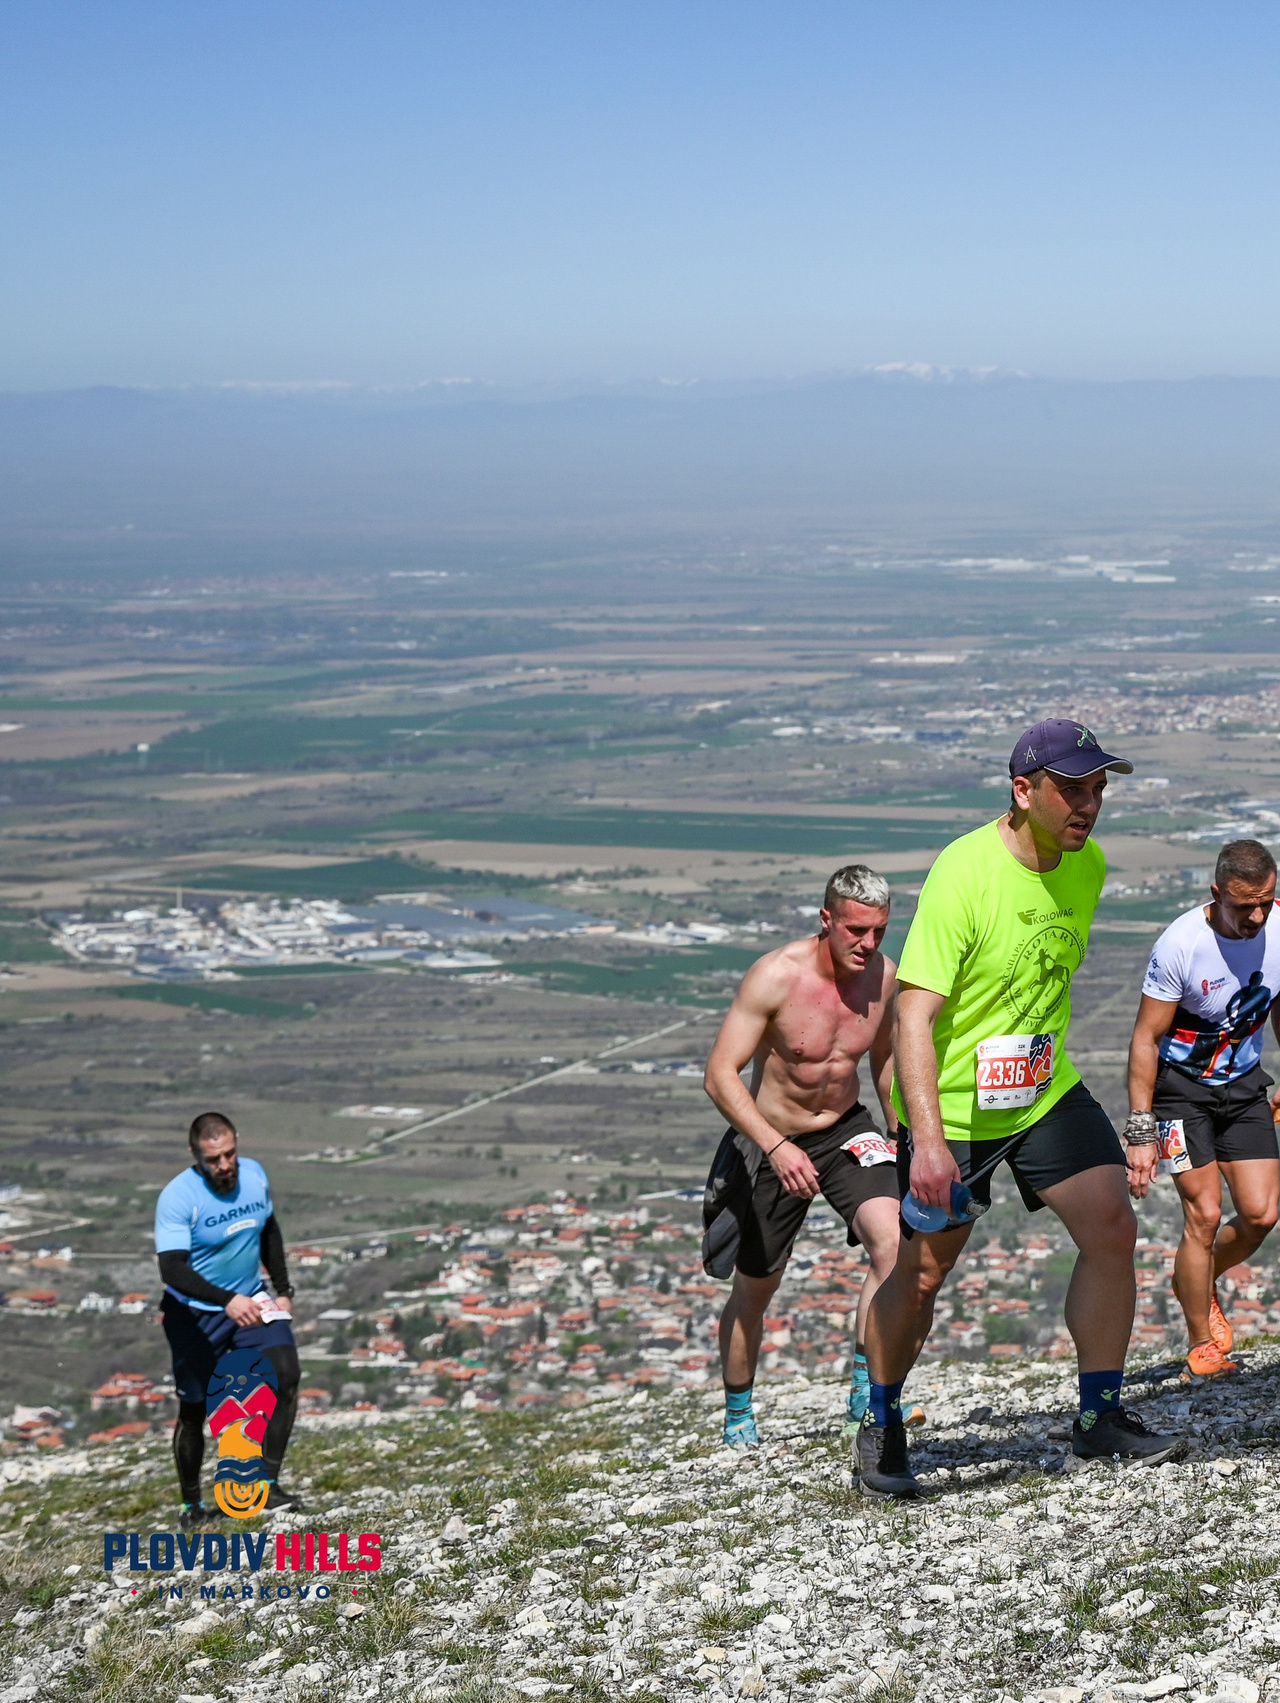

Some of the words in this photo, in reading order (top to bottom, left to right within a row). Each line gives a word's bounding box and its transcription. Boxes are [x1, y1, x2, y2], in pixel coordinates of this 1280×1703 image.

[1033, 908, 1074, 925] KOLOWAG
[1023, 930, 1077, 961] ROTARY
[978, 1060, 1027, 1087] 2336
[204, 1201, 265, 1227] GARMIN
